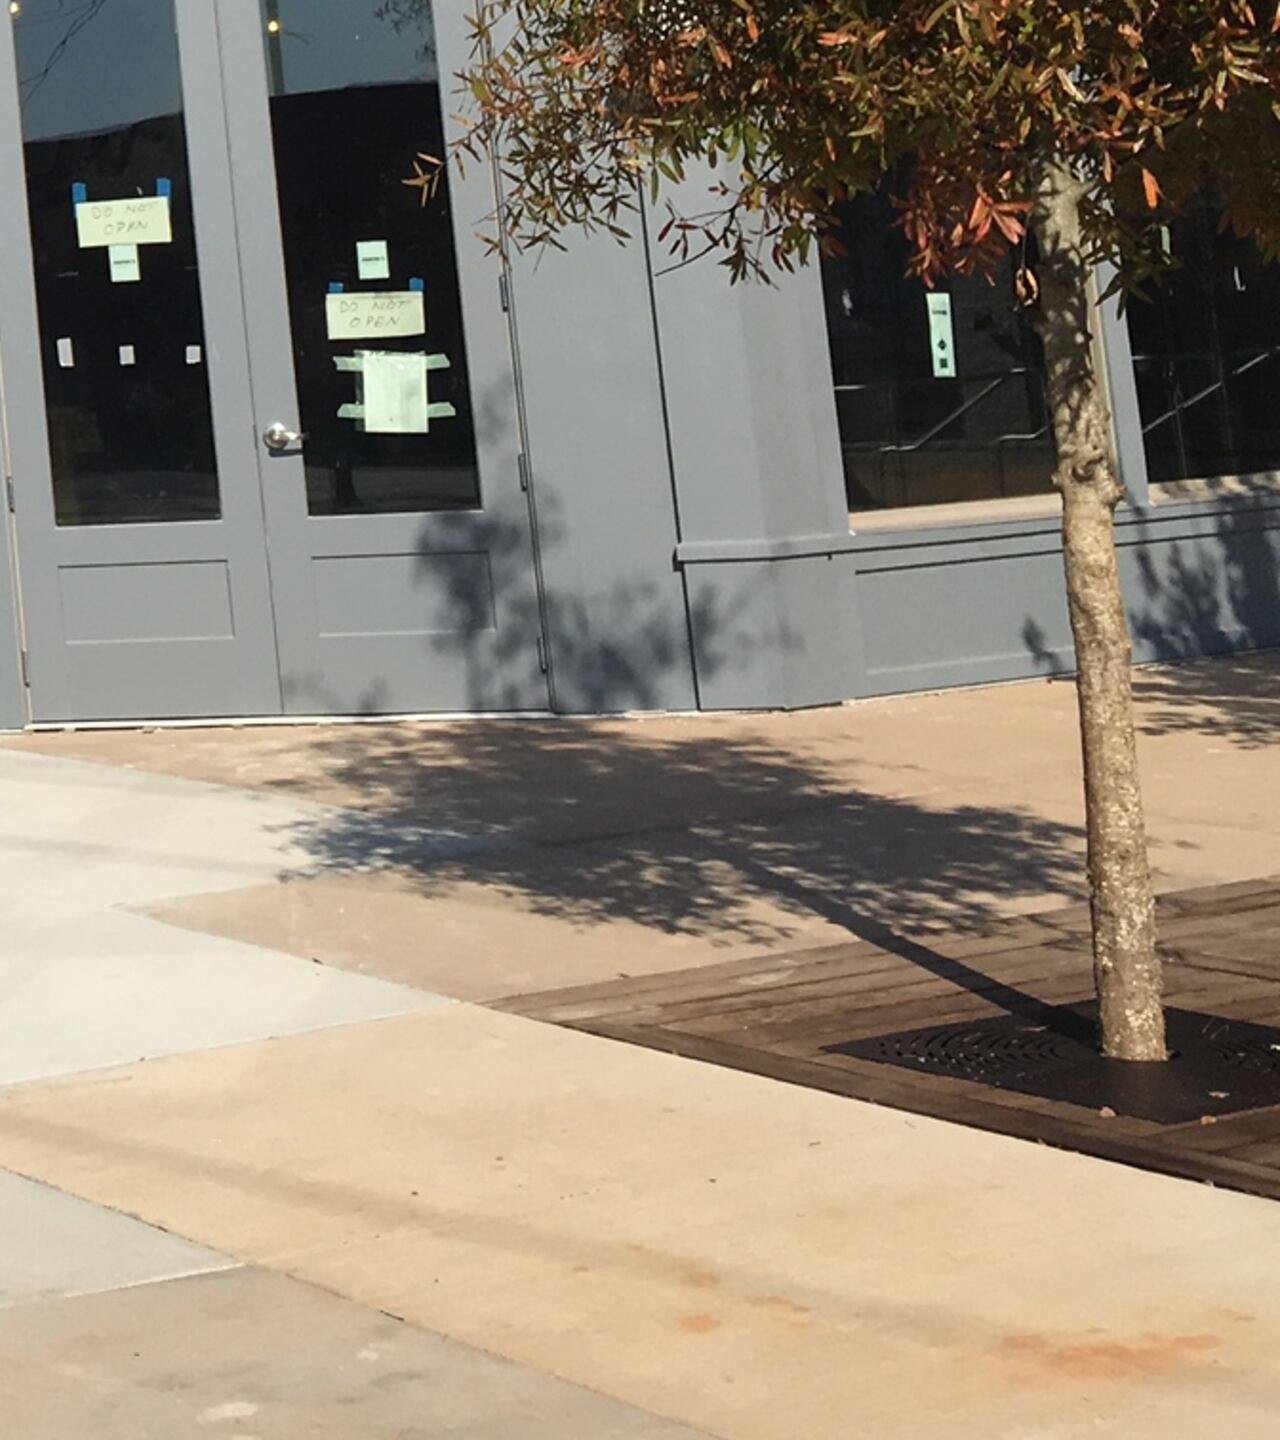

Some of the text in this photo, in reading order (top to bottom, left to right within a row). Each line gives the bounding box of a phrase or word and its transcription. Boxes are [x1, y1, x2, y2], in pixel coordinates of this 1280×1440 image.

[339, 300, 412, 313] DO NOT
[350, 316, 401, 329] OPEN
